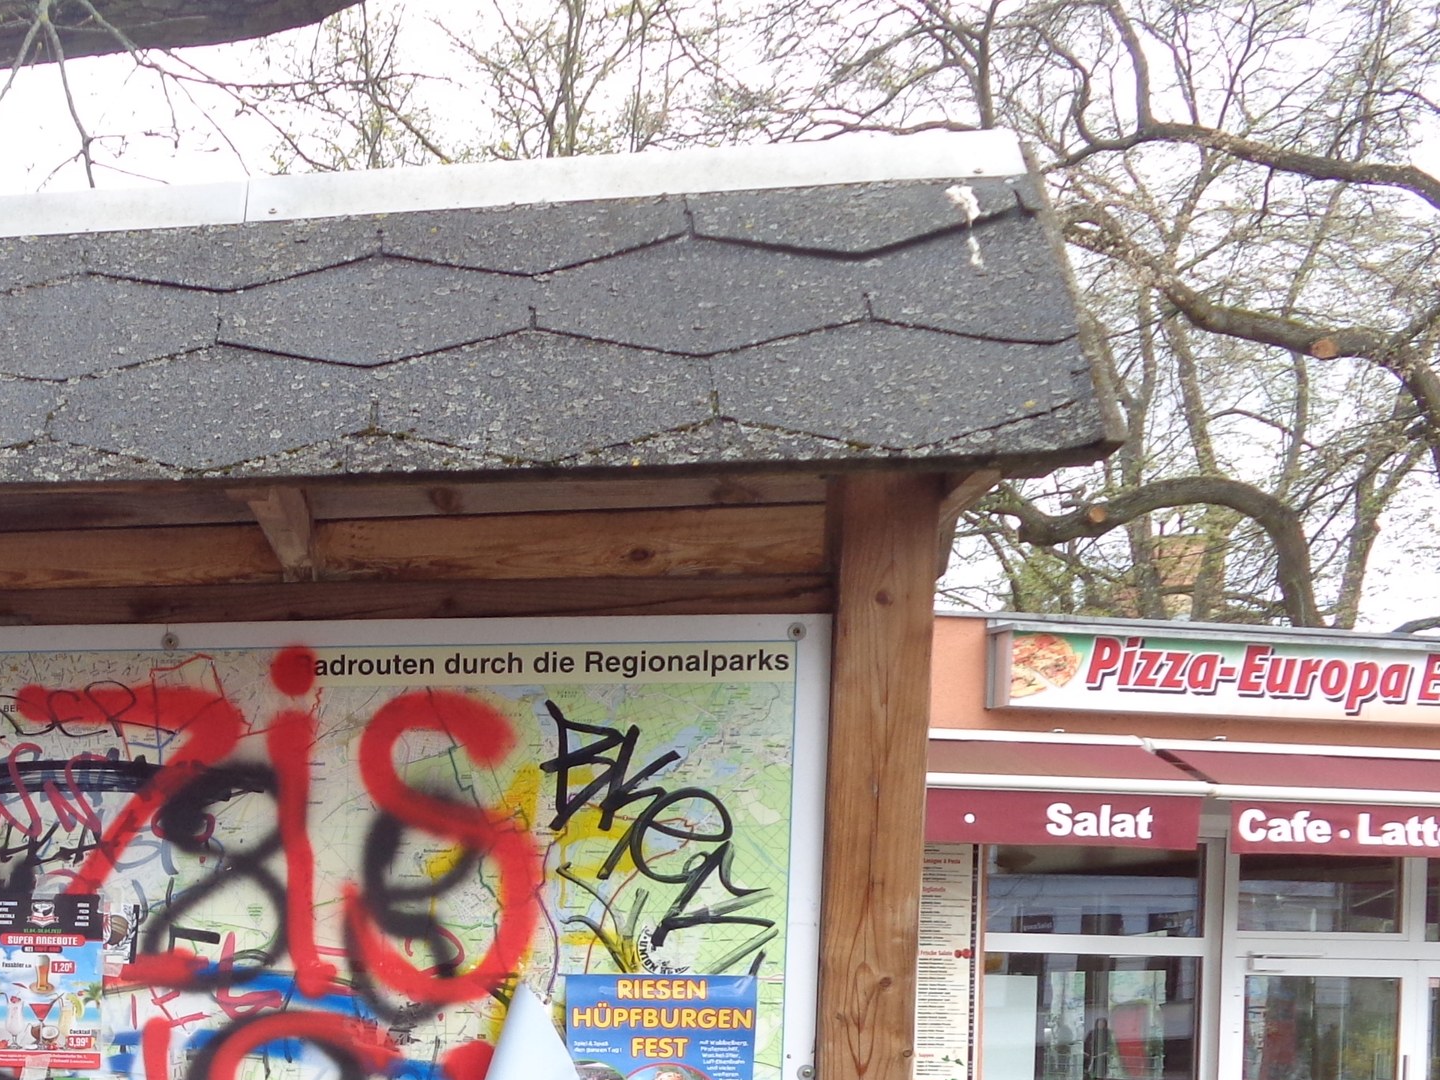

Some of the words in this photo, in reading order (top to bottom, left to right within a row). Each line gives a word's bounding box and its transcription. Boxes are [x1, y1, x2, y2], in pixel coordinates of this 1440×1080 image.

[302, 654, 434, 675] adrouten
[444, 653, 523, 674] durch
[533, 652, 574, 673] die
[585, 649, 789, 677] Regionalparks
[1086, 635, 1414, 715] Pizza-Europa
[1046, 803, 1153, 839] Salat
[1239, 809, 1331, 843] Cafe
[1357, 813, 1440, 846] Latt
[8, 936, 33, 944] SUPER
[617, 979, 706, 1000] RIESEN
[573, 1003, 752, 1028] HÜPFBURGEN
[632, 1037, 688, 1057] FEST
